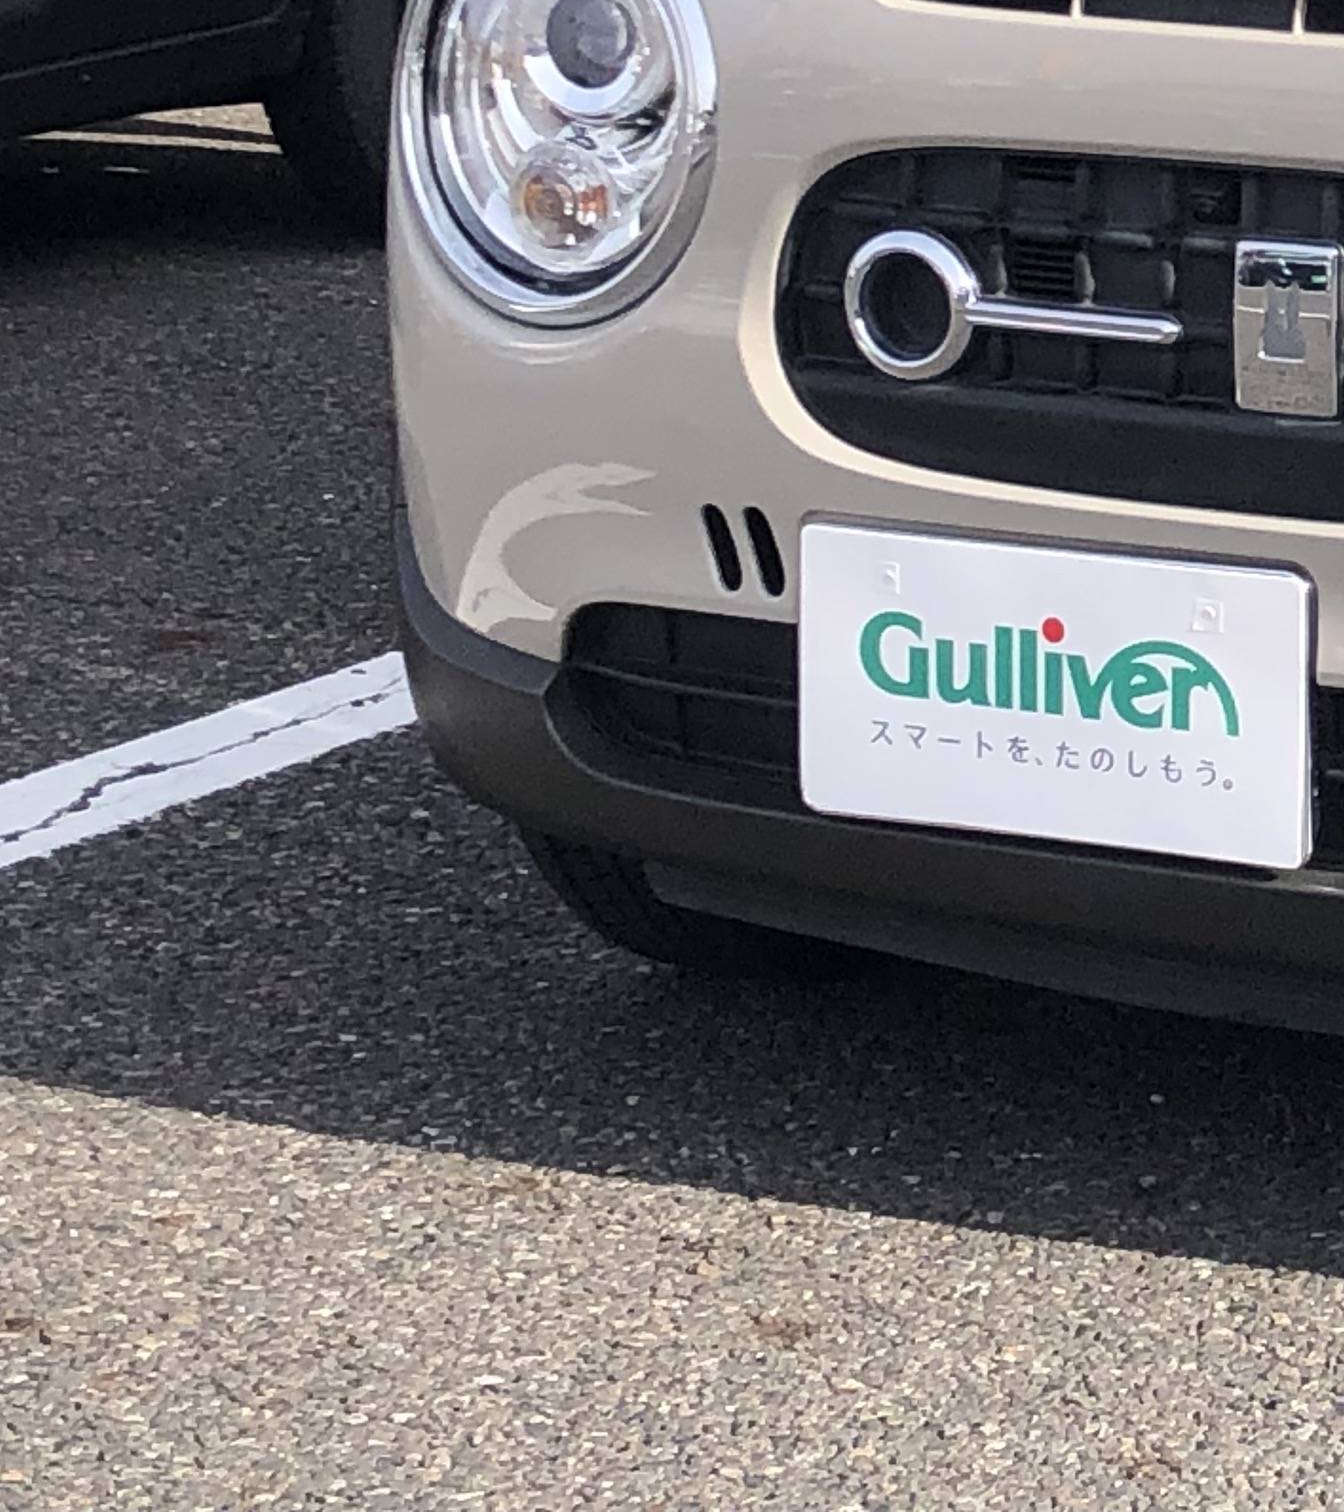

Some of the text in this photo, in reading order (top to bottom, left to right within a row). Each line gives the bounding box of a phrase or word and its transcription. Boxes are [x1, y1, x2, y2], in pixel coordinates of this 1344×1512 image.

[859, 609, 1240, 738] Gulliver
[870, 719, 1234, 791] スマートを、たのしもう。
